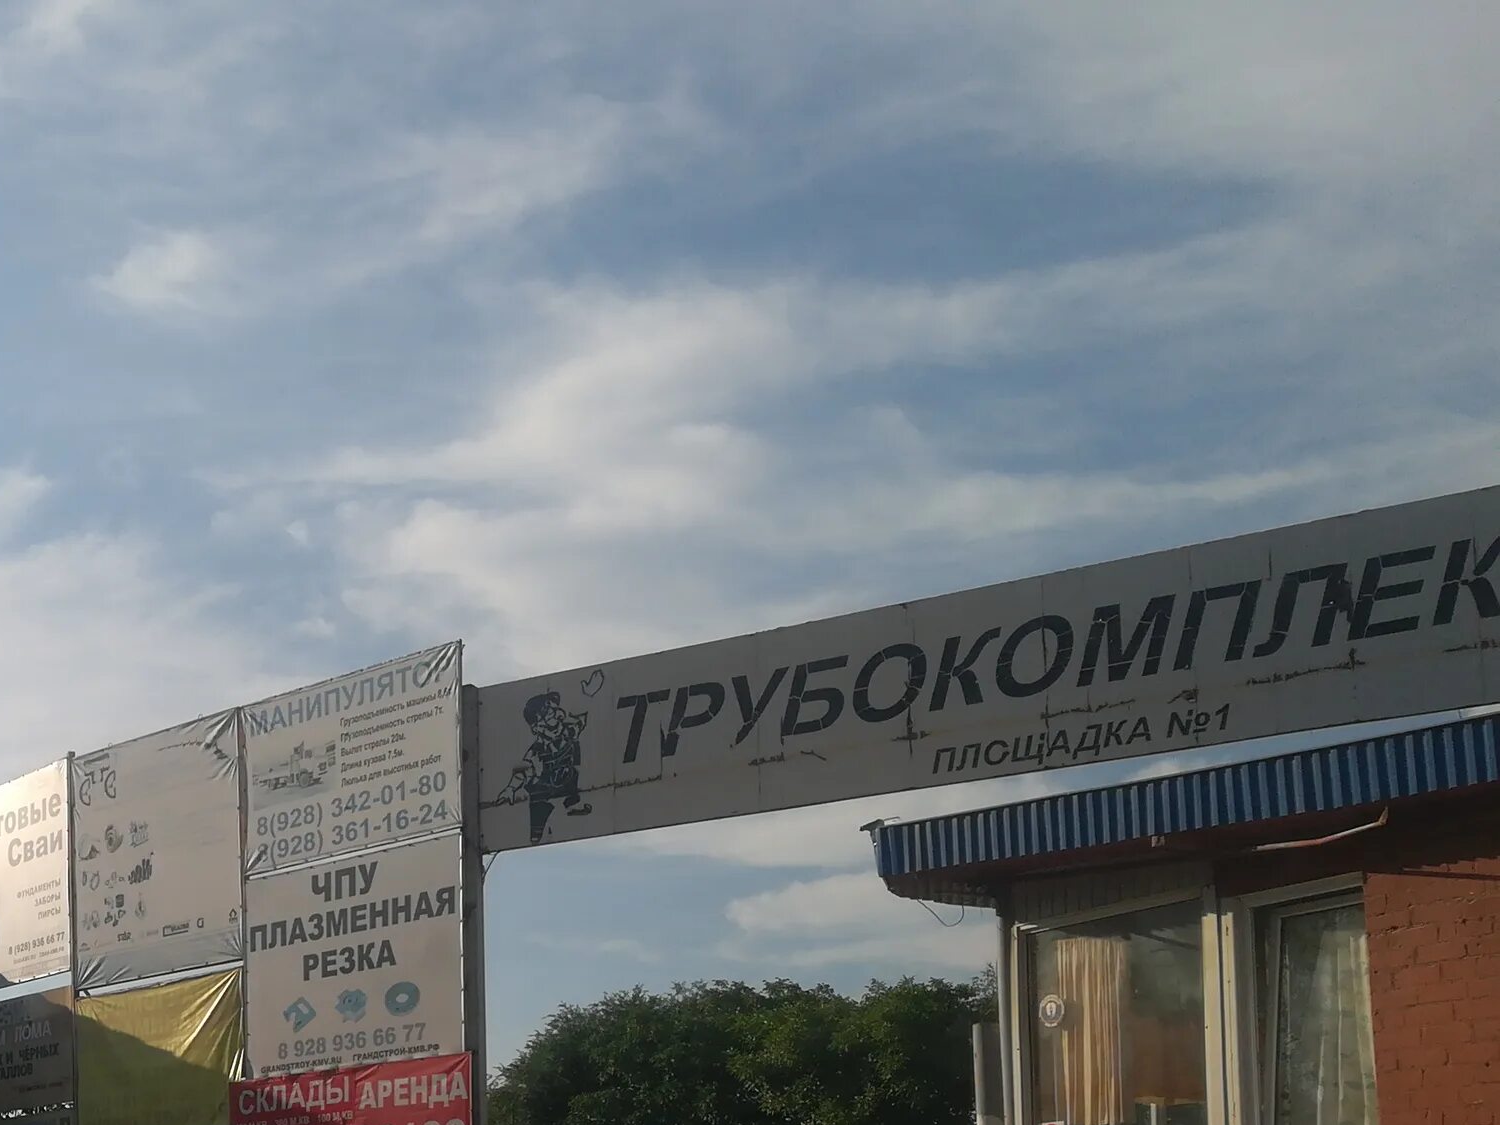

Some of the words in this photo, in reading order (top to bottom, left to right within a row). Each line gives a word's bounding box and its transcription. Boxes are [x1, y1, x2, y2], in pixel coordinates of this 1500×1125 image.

[617, 536, 1500, 764] ТРУБОКОМПЛЕК
[932, 716, 1153, 775] ПЛОЩАДКА
[1167, 702, 1231, 738] №1
[257, 802, 323, 838] 8(928)
[331, 771, 447, 818] 342-01-80
[332, 799, 449, 846] 361-16-24
[8, 829, 63, 867] Сваи
[311, 861, 378, 902] ЧПУ
[250, 885, 456, 953] ПЛАЗМЕННАЯ
[303, 939, 397, 981] РЕЗКА
[278, 1042, 288, 1060] 8
[293, 1037, 326, 1057] 928
[332, 1031, 366, 1051] 936
[372, 1026, 396, 1045] 66
[402, 1022, 426, 1041] 77
[238, 1076, 349, 1115] СКЛАДЫ
[358, 1071, 468, 1110] АРЕНДА
